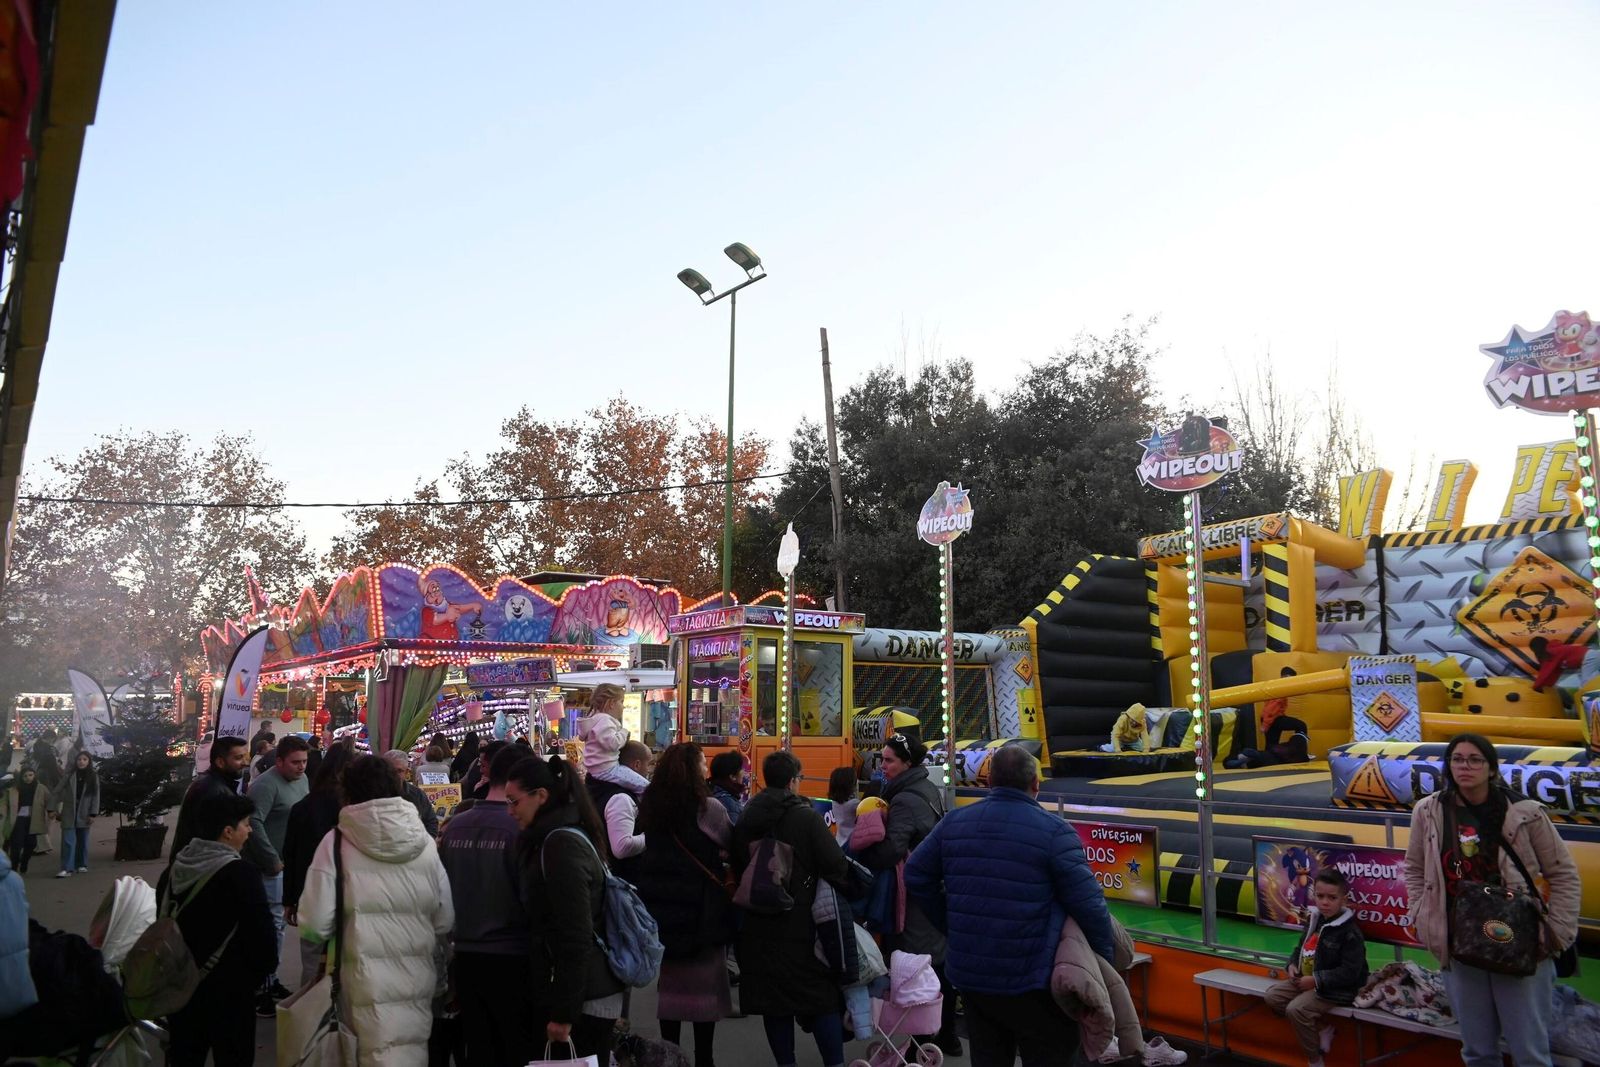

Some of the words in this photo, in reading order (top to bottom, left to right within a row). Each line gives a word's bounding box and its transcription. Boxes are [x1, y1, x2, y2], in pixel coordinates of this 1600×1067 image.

[1137, 450, 1242, 481] WIPEOUT
[918, 511, 974, 534] WIPEOUT
[1208, 523, 1257, 544] LIBRE
[773, 611, 841, 628] WPEOUT
[1356, 674, 1412, 686] DANGER
[429, 787, 459, 801] OFRES
[1336, 861, 1398, 880] WIPEOUT
[1354, 909, 1412, 927] EDAD
